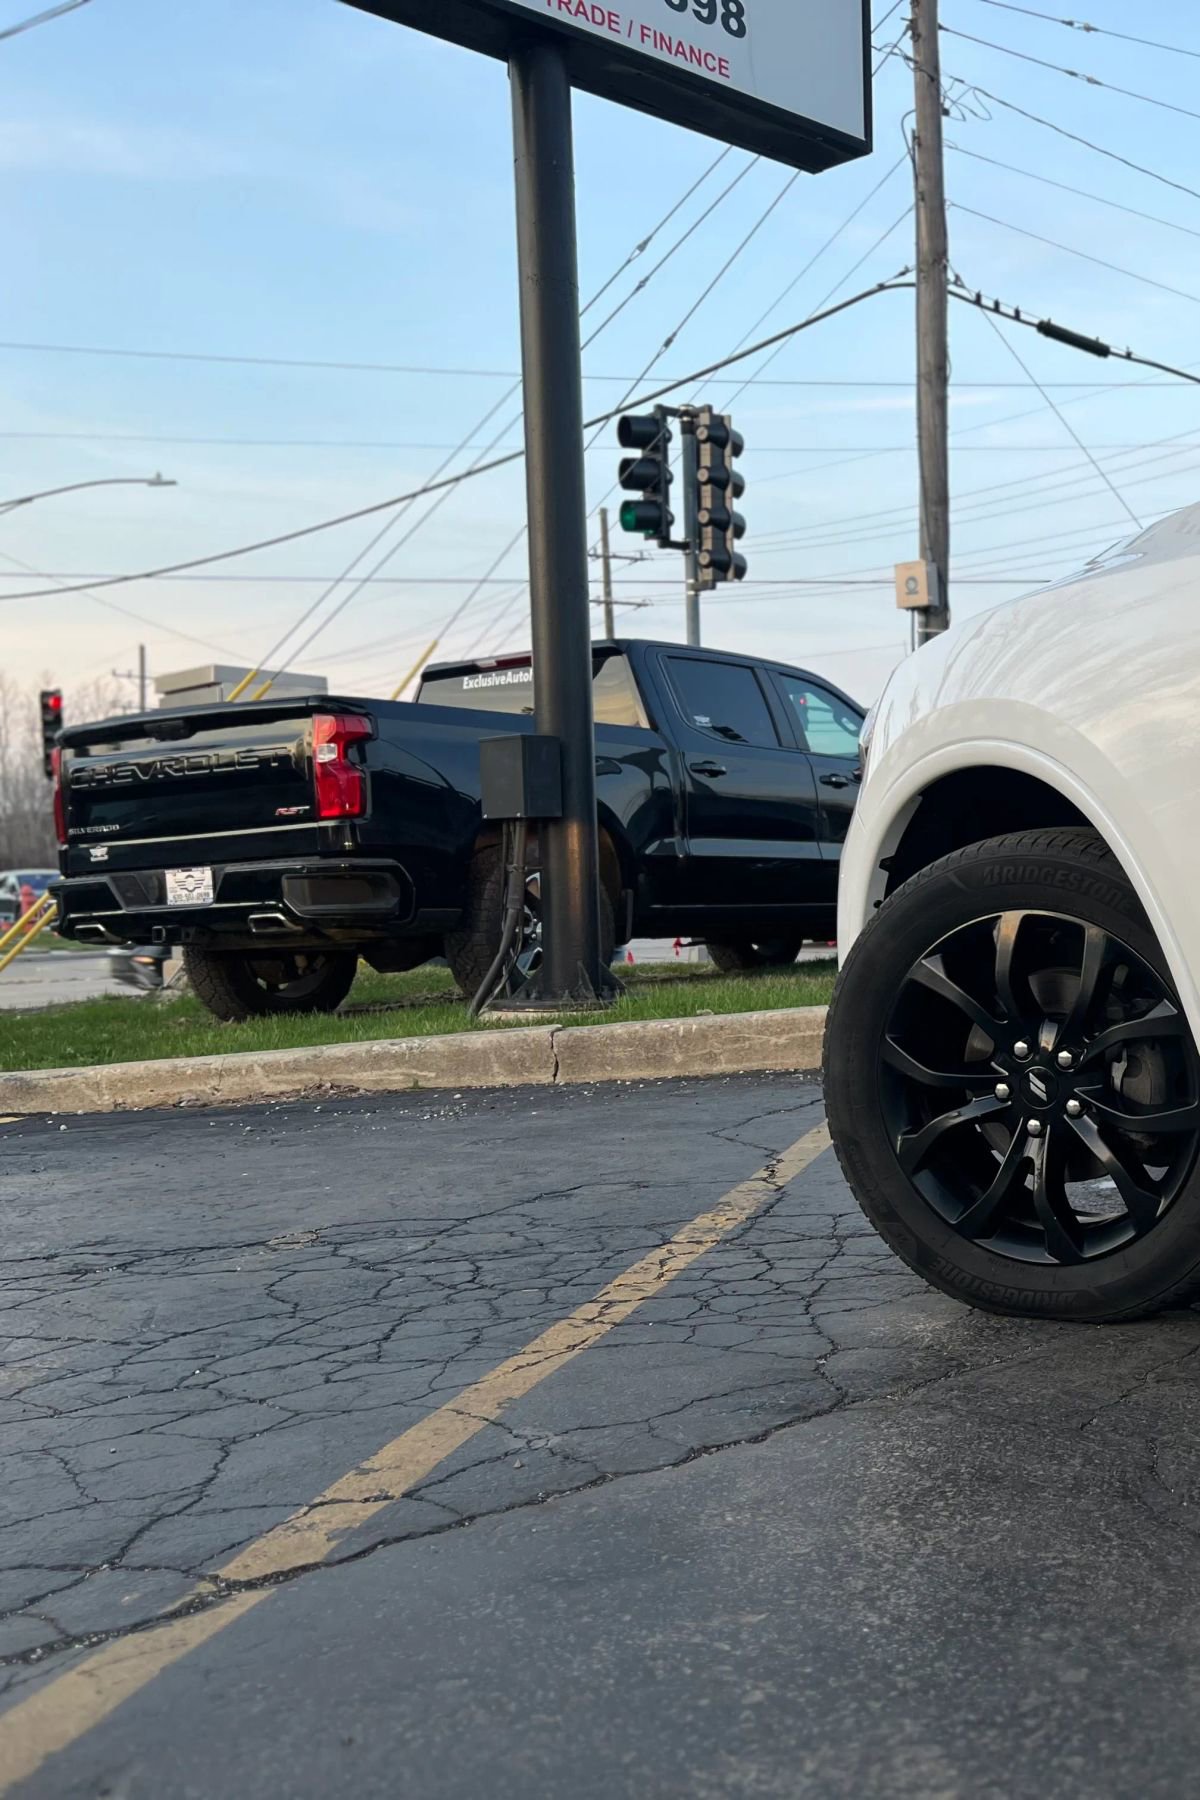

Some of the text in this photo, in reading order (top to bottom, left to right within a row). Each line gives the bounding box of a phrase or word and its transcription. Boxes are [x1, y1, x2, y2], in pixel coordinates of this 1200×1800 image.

[664, 0, 746, 38] 98
[640, 24, 731, 79] FINANCE
[70, 747, 288, 789] CHEVROLET
[68, 824, 120, 836] SILVERADO
[275, 805, 310, 816] RST
[983, 864, 1135, 915] BRIDGESTONE
